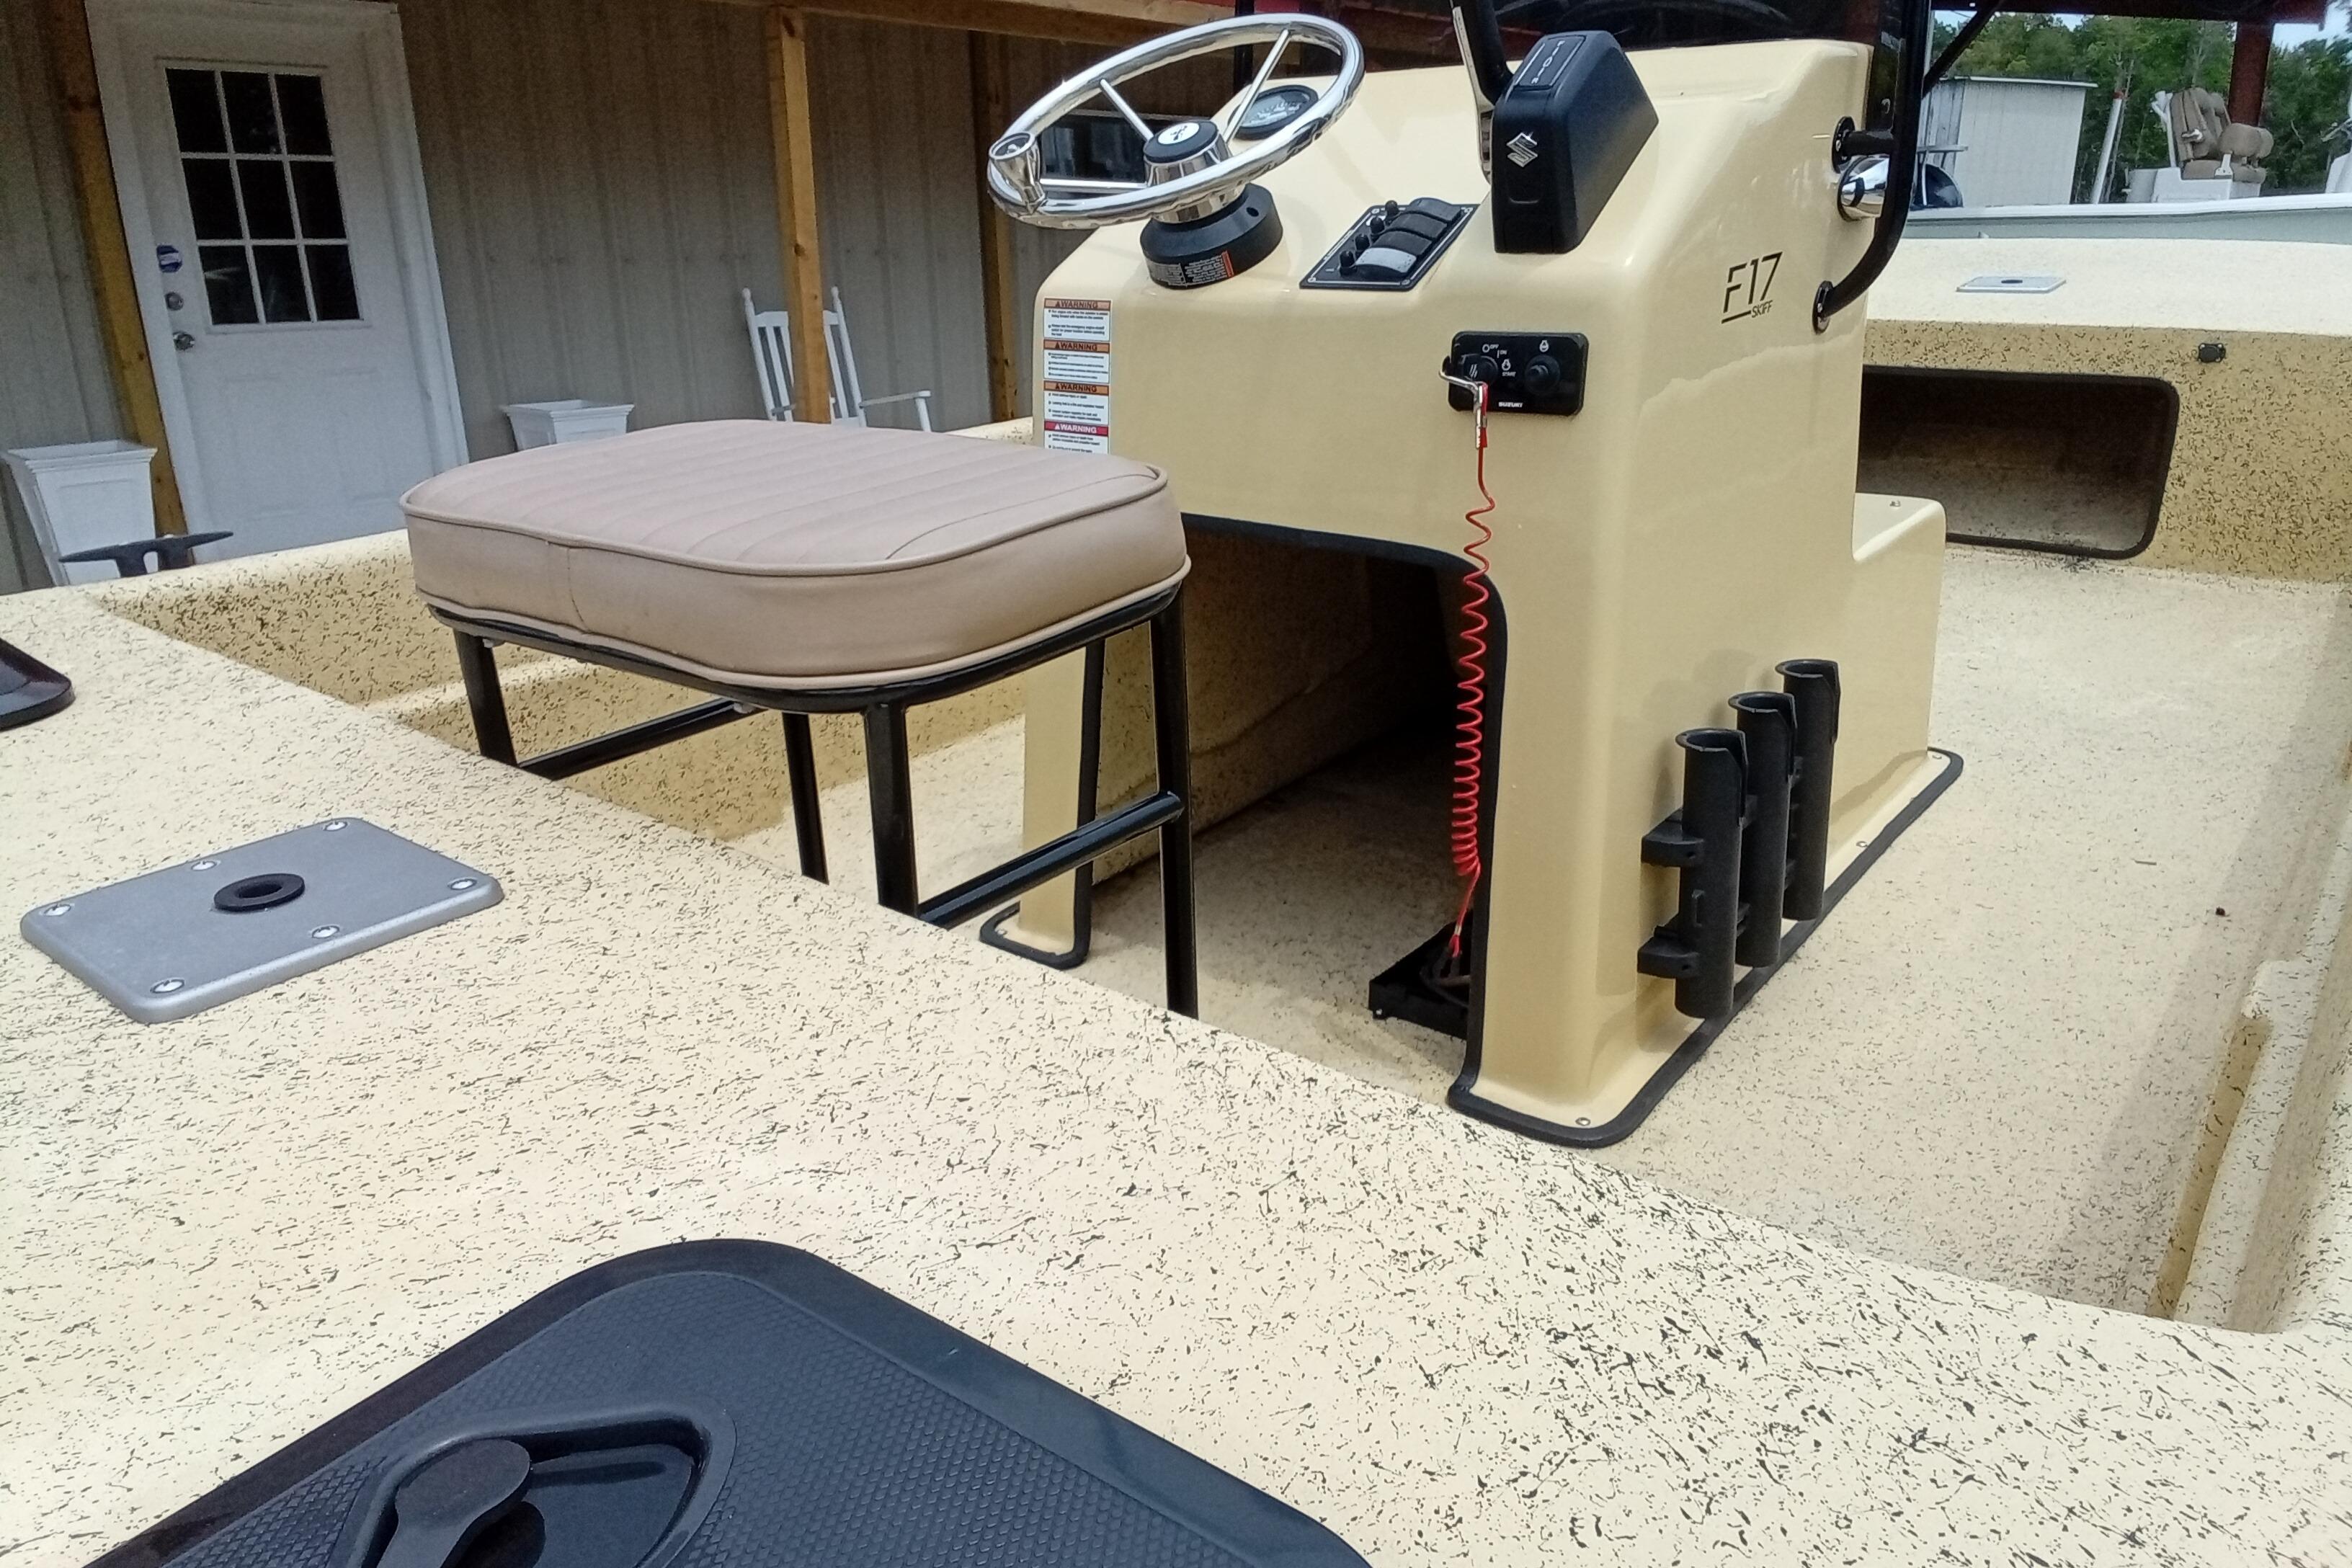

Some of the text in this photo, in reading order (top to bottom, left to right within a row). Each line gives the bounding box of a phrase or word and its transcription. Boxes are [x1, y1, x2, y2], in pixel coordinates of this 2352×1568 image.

[1724, 251, 1783, 313] F17
[1061, 300, 1098, 309] WARNING
[1752, 300, 1773, 318] SKIFF
[1061, 342, 1097, 352] WARNING
[1060, 383, 1097, 393] WARNING
[1060, 423, 1097, 434] WARNING
